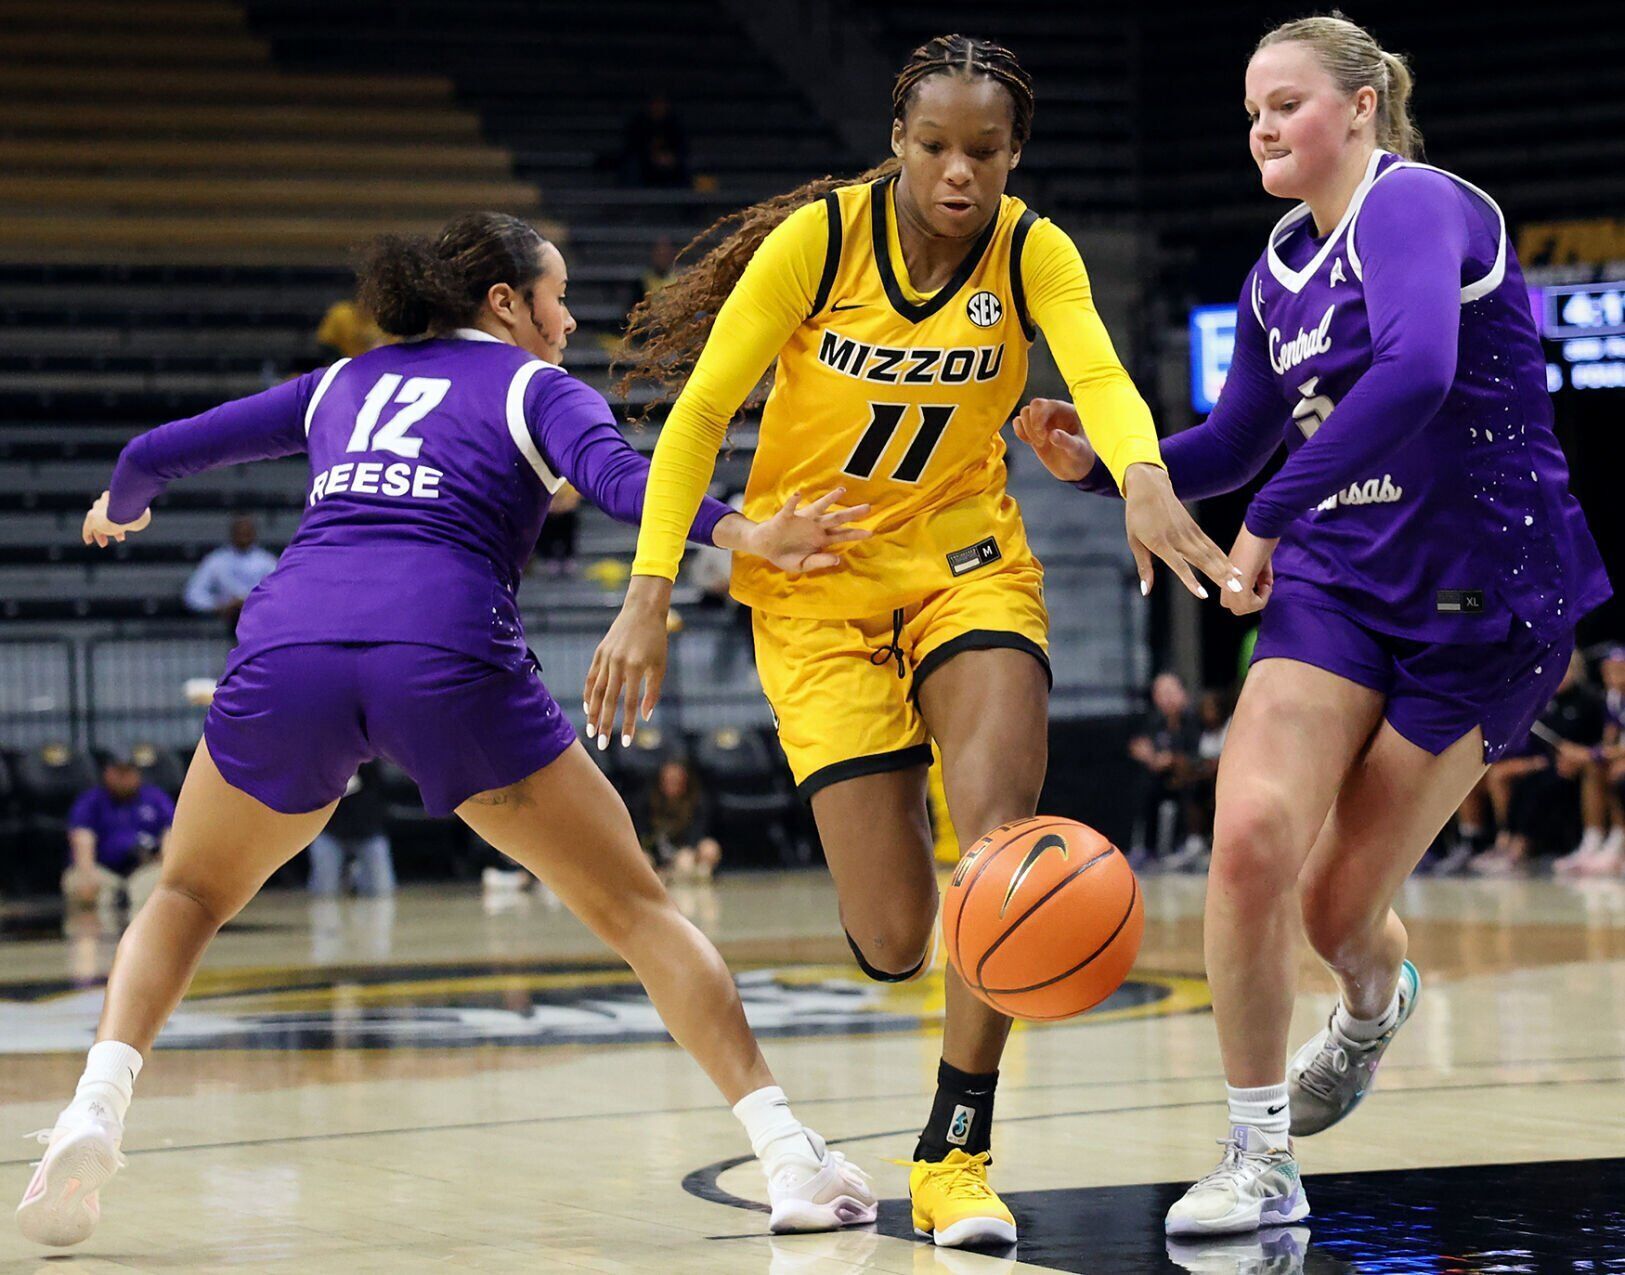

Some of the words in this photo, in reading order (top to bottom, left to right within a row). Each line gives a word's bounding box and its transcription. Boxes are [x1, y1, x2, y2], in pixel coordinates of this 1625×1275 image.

[968, 292, 1001, 326] SEC
[818, 329, 1004, 384] MIZZOU
[1268, 303, 1335, 374] Central
[345, 373, 452, 458] 12
[840, 400, 959, 484] 11
[309, 463, 443, 506] REESE
[982, 545, 993, 558] M
[1466, 596, 1479, 607] XL
